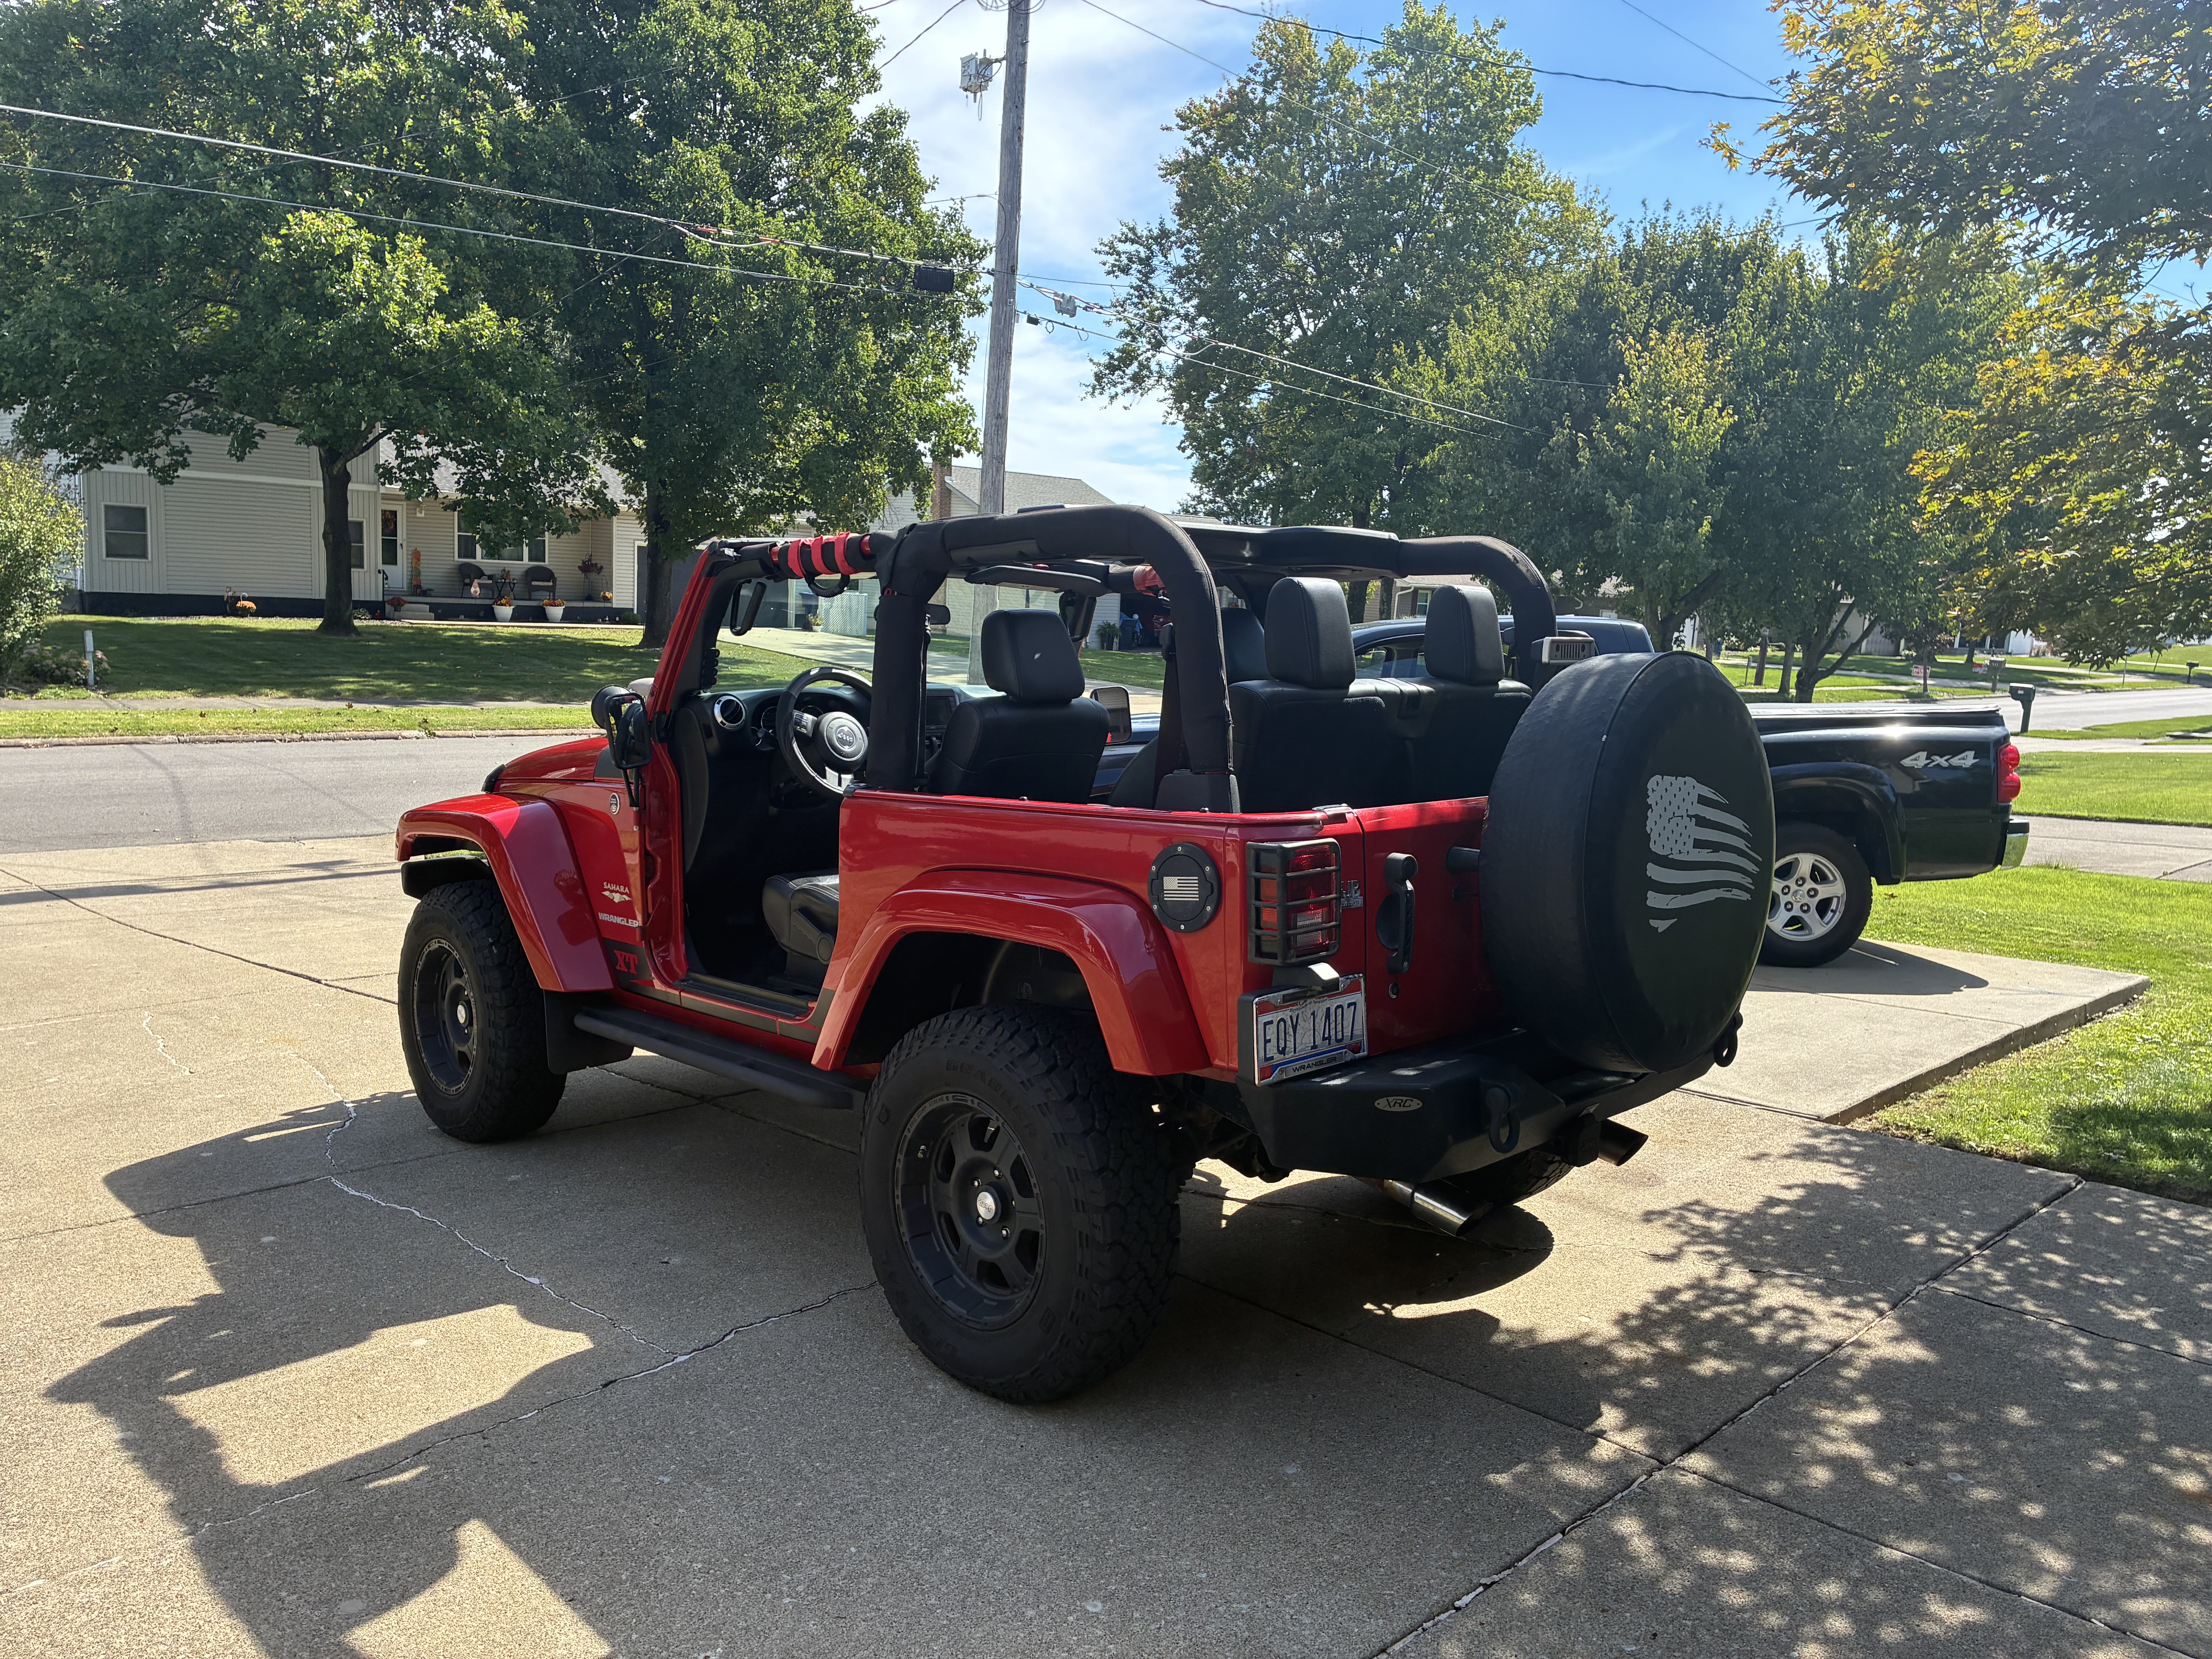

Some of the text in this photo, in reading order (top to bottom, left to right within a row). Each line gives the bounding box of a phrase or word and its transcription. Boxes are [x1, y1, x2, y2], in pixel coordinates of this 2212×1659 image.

[1900, 750, 1980, 768] 4x4
[603, 882, 629, 893] SAHARA
[598, 912, 639, 927] WRANGLER
[614, 950, 638, 974] XT
[1263, 1001, 1357, 1062] EQY 1407
[1292, 1056, 1336, 1073] WRANGLER
[946, 1059, 1039, 1138] GRABBER
[1383, 1098, 1413, 1108] XRC
[978, 1199, 994, 1212] Jeep
